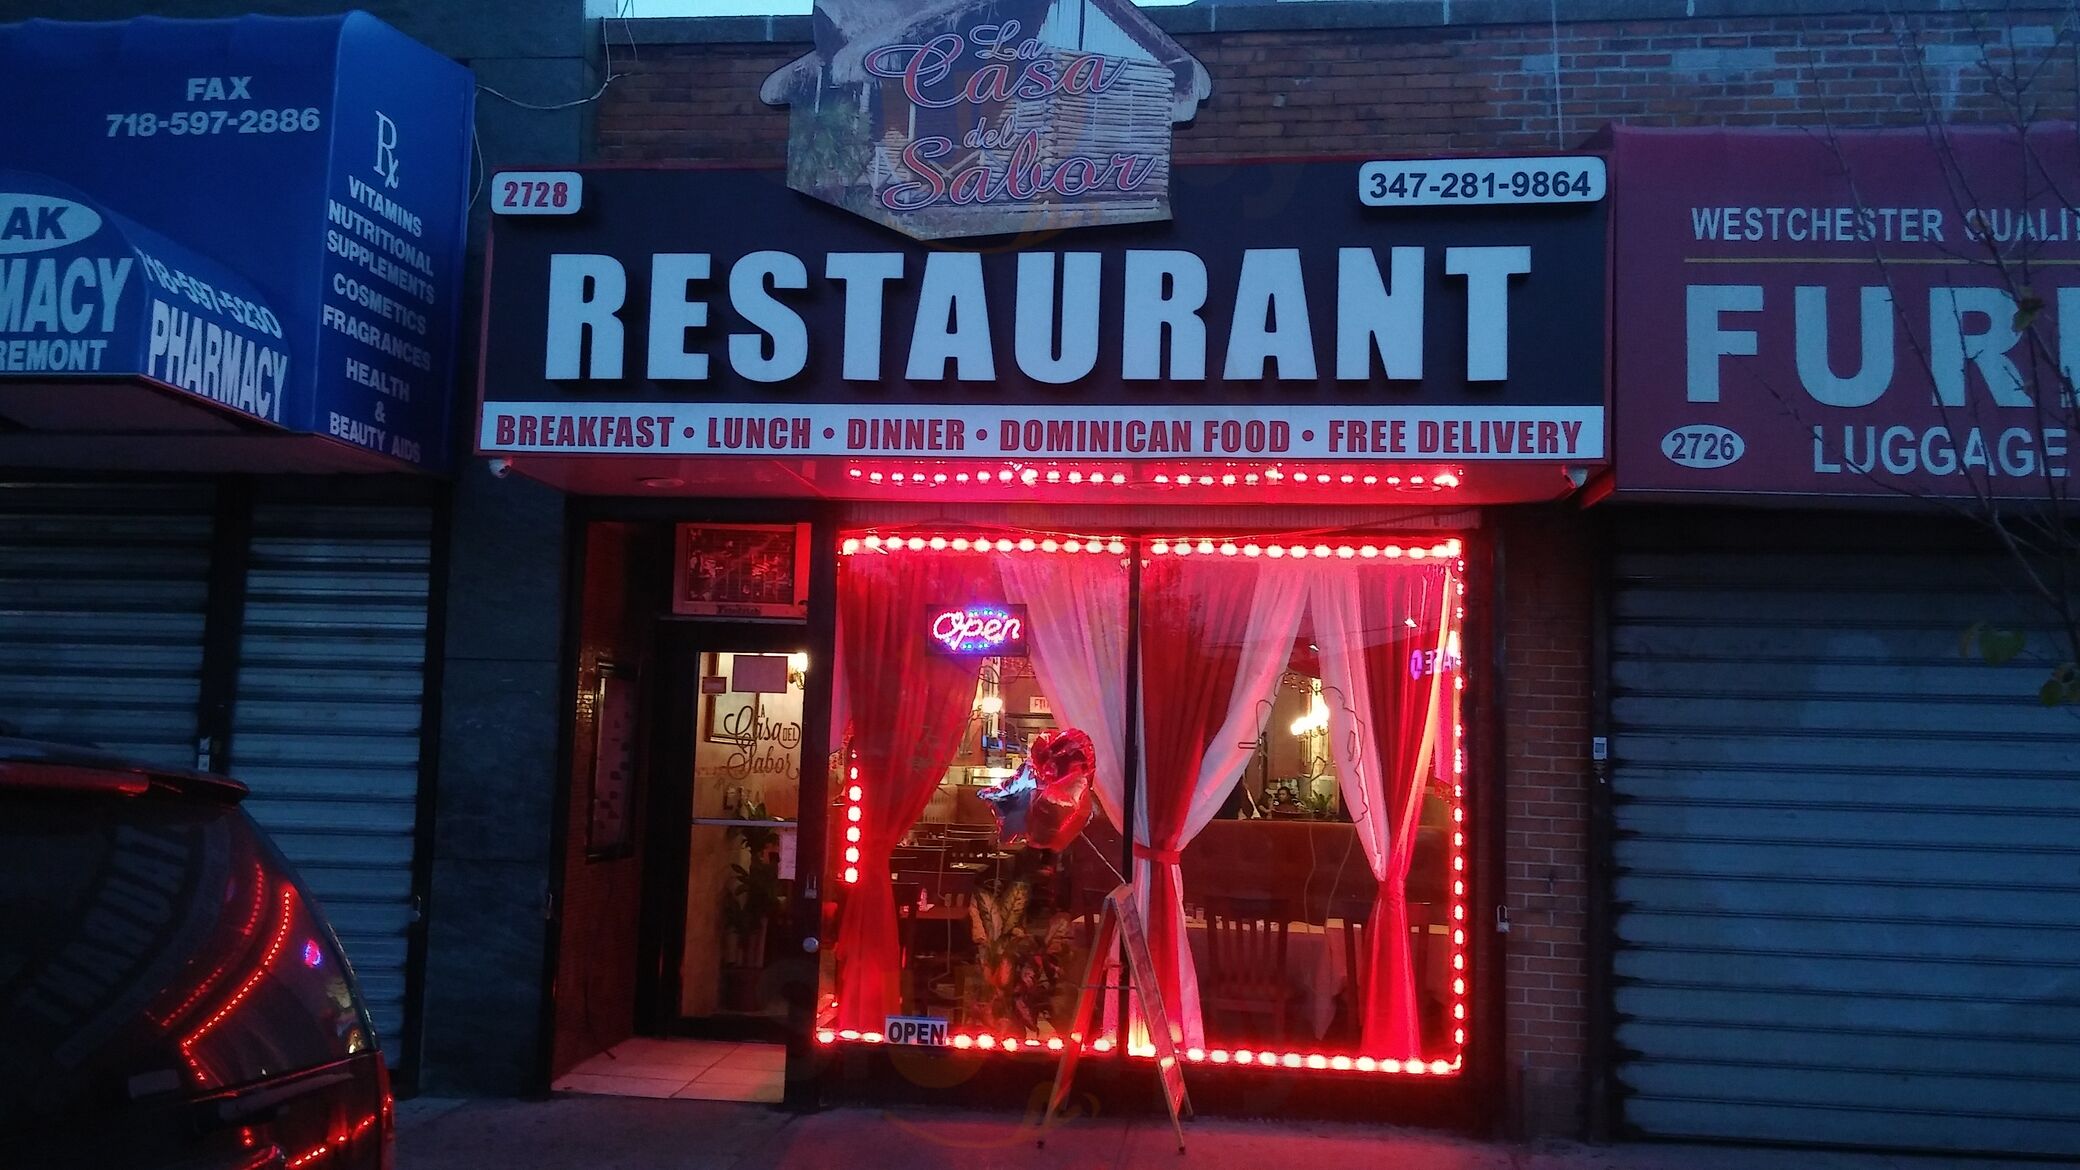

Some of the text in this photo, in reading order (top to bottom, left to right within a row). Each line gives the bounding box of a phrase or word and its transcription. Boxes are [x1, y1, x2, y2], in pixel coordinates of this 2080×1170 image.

[968, 19, 1045, 61] La
[187, 76, 253, 101] FAX
[864, 33, 1129, 109] Casa
[106, 107, 321, 137] 718-597-2886
[963, 115, 1018, 149] del
[881, 128, 1157, 211] Sabor
[1369, 170, 1591, 200] 347-281-9864
[349, 174, 422, 237] VITAMINS
[503, 181, 569, 208] 2728
[1, 206, 68, 240] AK
[328, 199, 434, 277] NUTRITIONAL
[1691, 207, 1945, 242] WESTCHESTER
[327, 229, 435, 304] SUPPLEMENTS
[133, 247, 283, 339] 718-597-5230
[333, 272, 427, 335] COSMETICS
[545, 246, 1532, 384] RESTAURANT
[322, 304, 431, 371] FRAGRANCES
[148, 298, 288, 423] PHARMACY
[346, 357, 410, 402] HEALTH
[374, 400, 386, 424] &
[329, 411, 421, 463] BEAUTY AIDS
[496, 414, 1583, 454] BREAKFAST LUNCH DINNER DOMINICAN FOOD FREE DELIVERY
[1671, 432, 1735, 461] 2726
[1813, 425, 2071, 477] LUGGAGE
[932, 611, 1020, 651] Open
[888, 1021, 945, 1046] OPEN
